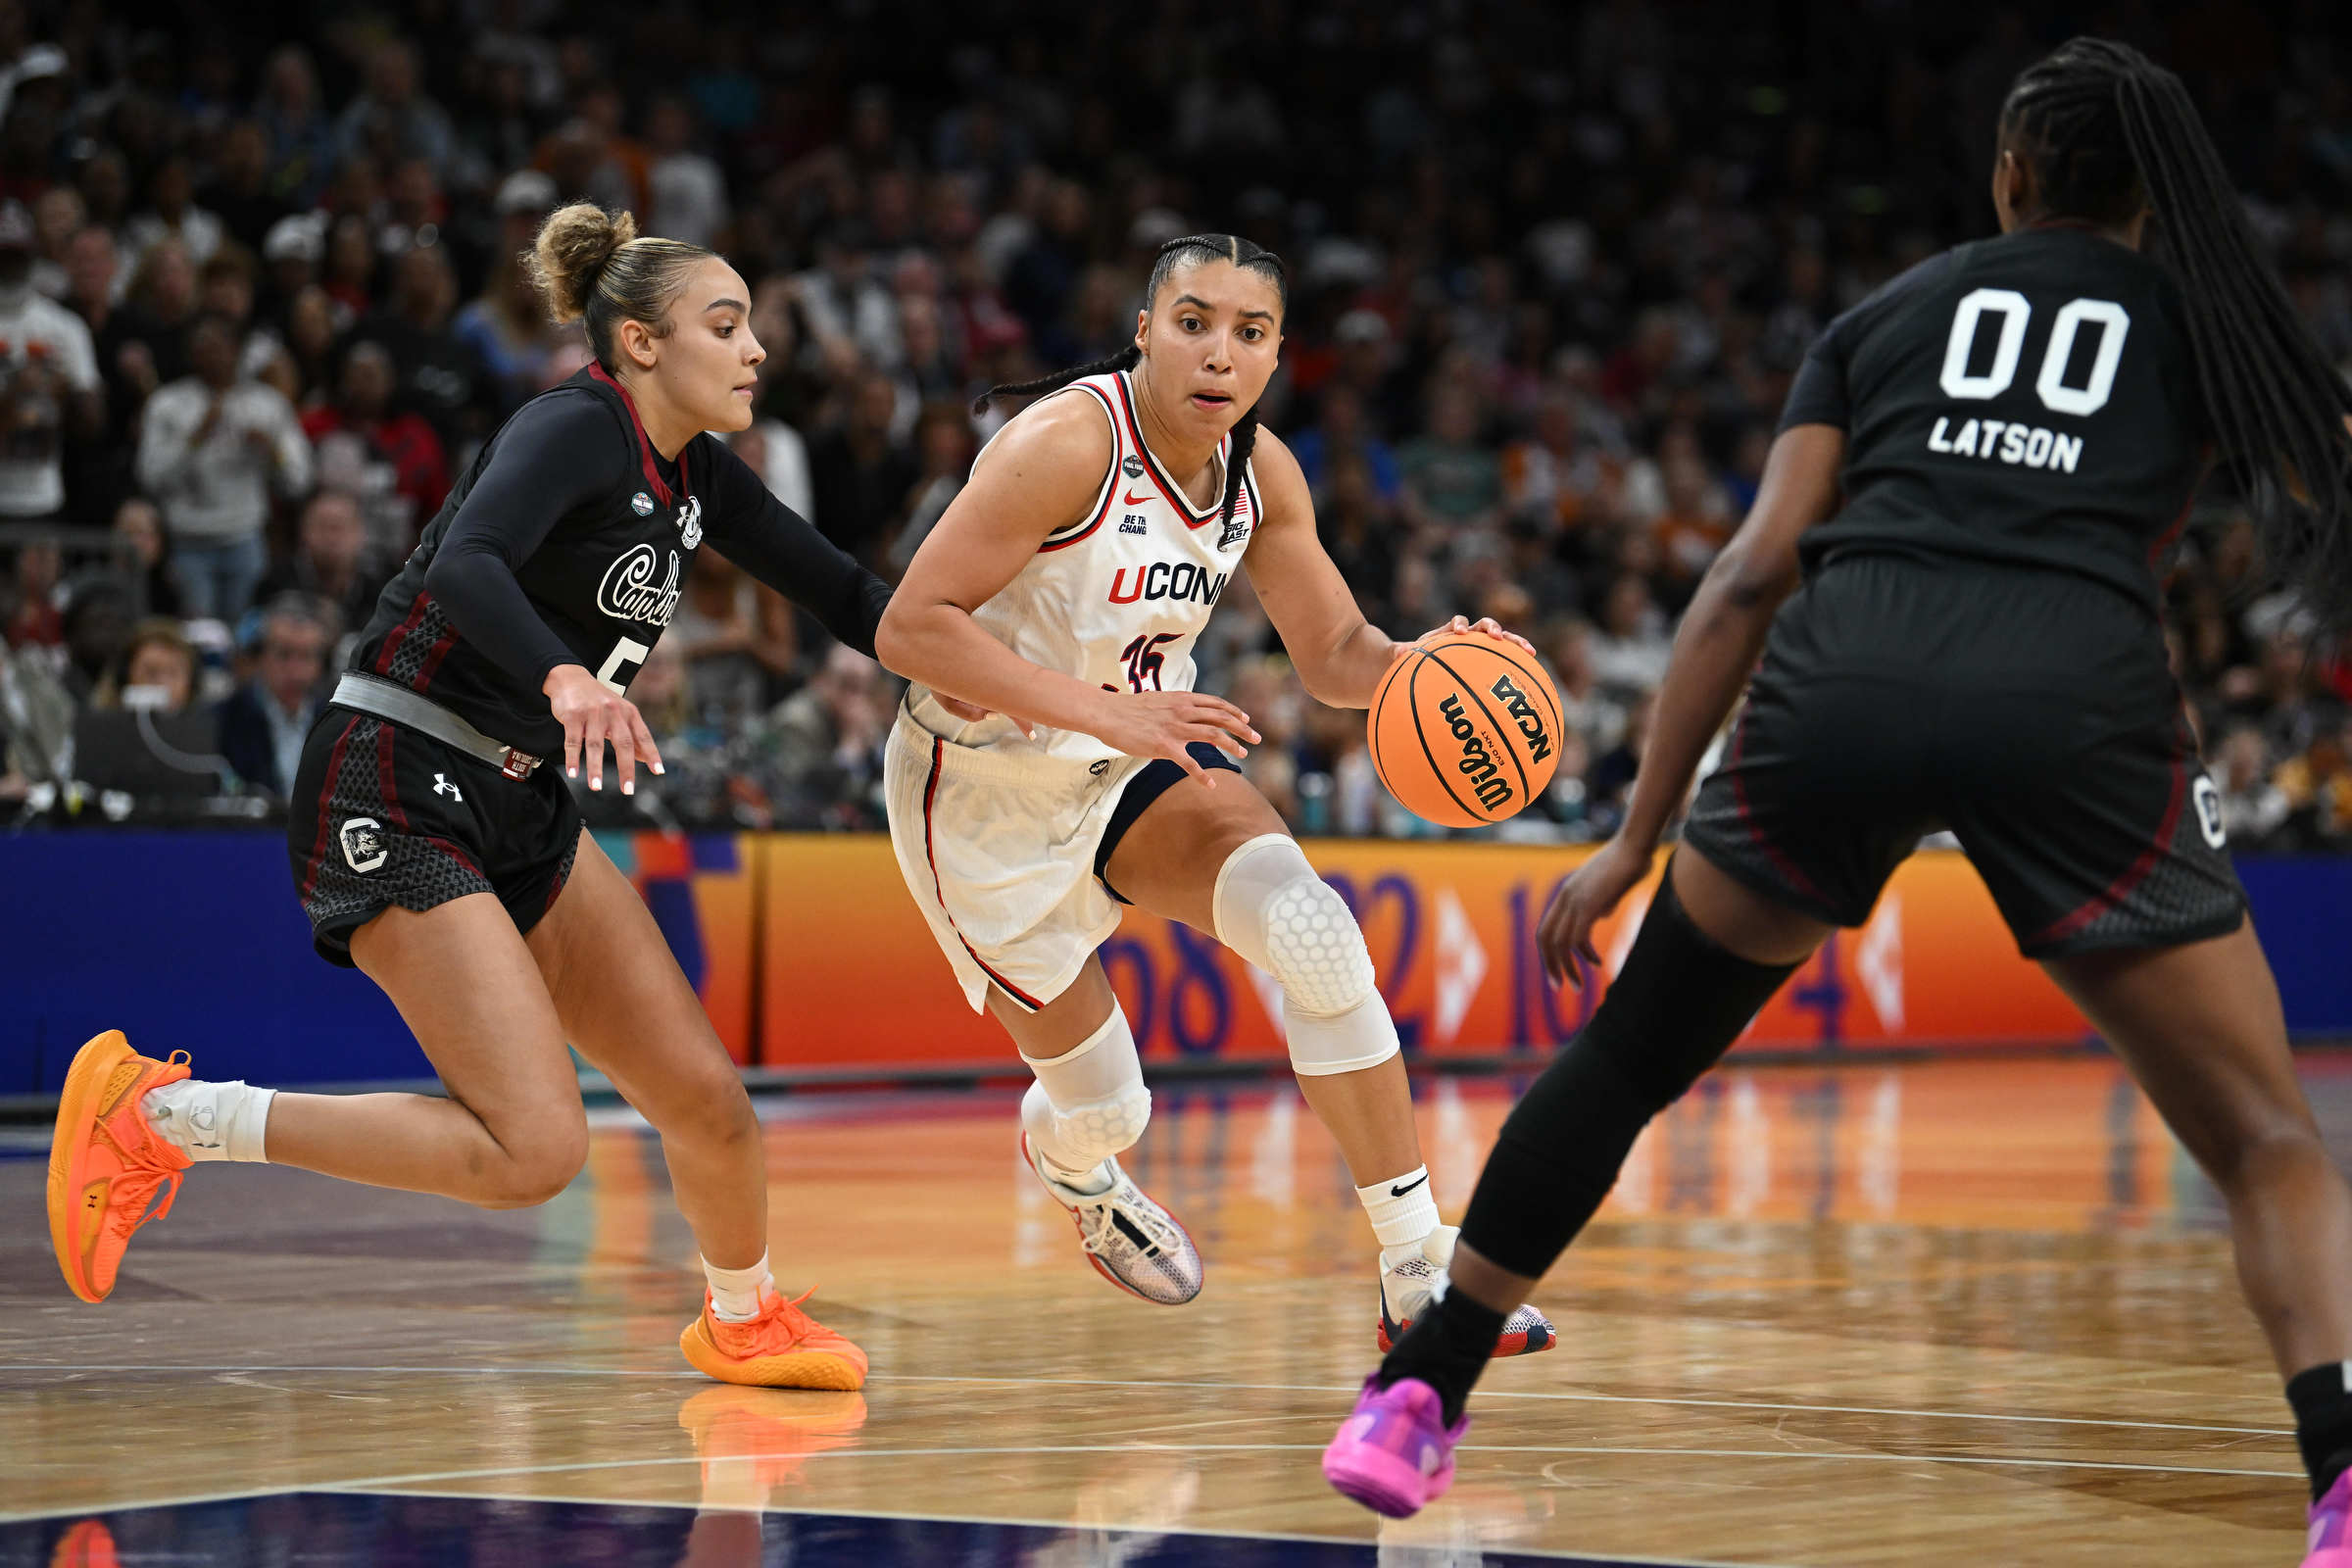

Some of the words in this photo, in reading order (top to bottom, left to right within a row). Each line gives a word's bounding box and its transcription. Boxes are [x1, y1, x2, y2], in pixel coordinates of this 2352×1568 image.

[1939, 288, 2131, 416] 00
[1928, 416, 2083, 473] LATSON
[1123, 514, 1137, 524] BE
[1138, 515, 1147, 525] TH
[1118, 523, 1147, 535] CHANG
[1227, 528, 1250, 541] AST
[1490, 673, 1551, 765] NCAA
[1481, 731, 1494, 748] NXT
[1439, 692, 1514, 813] Wilson
[1492, 750, 1505, 766] EVO
